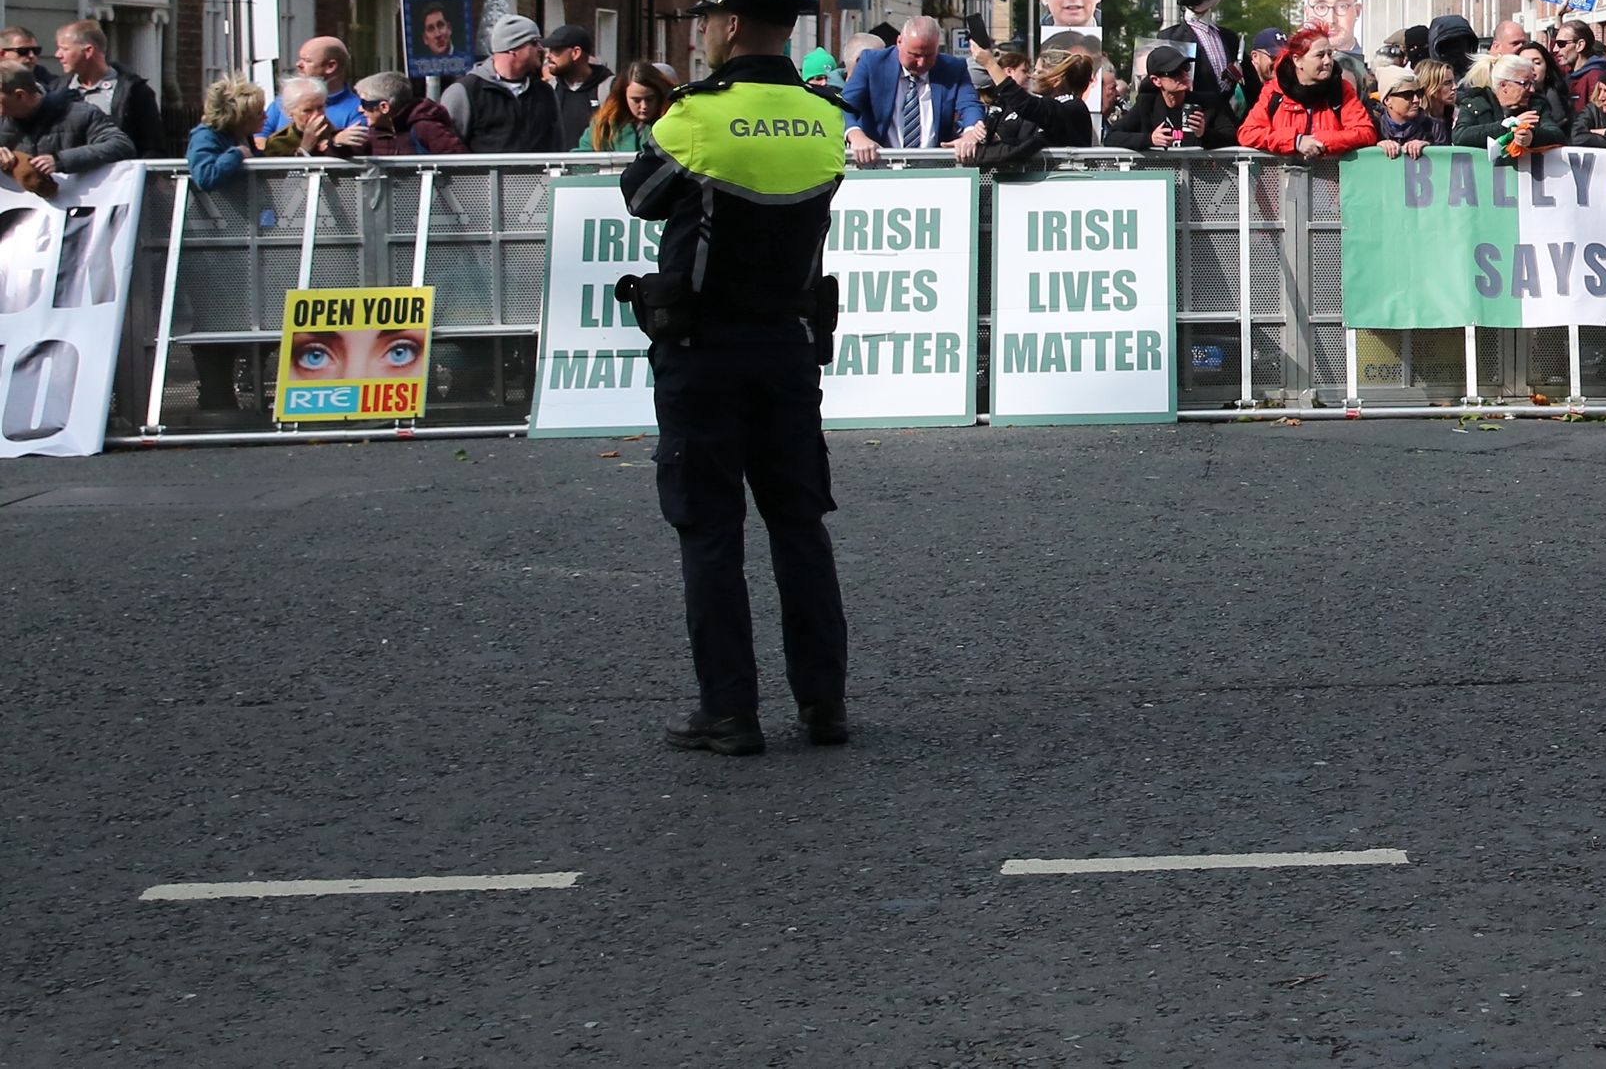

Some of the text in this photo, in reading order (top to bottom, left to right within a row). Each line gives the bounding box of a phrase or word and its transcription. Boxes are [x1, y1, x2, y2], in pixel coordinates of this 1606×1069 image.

[729, 118, 827, 137] GARDA
[827, 208, 941, 252] IRISH
[1027, 209, 1138, 252] IRISH
[293, 297, 425, 327] OPEN YOUR
[1028, 269, 1138, 313] LIVES
[549, 349, 655, 390] MAT
[823, 331, 961, 376] ATTER
[1003, 330, 1163, 373] MATTER
[289, 387, 352, 409] RTÉ
[360, 382, 418, 413] LIES!
